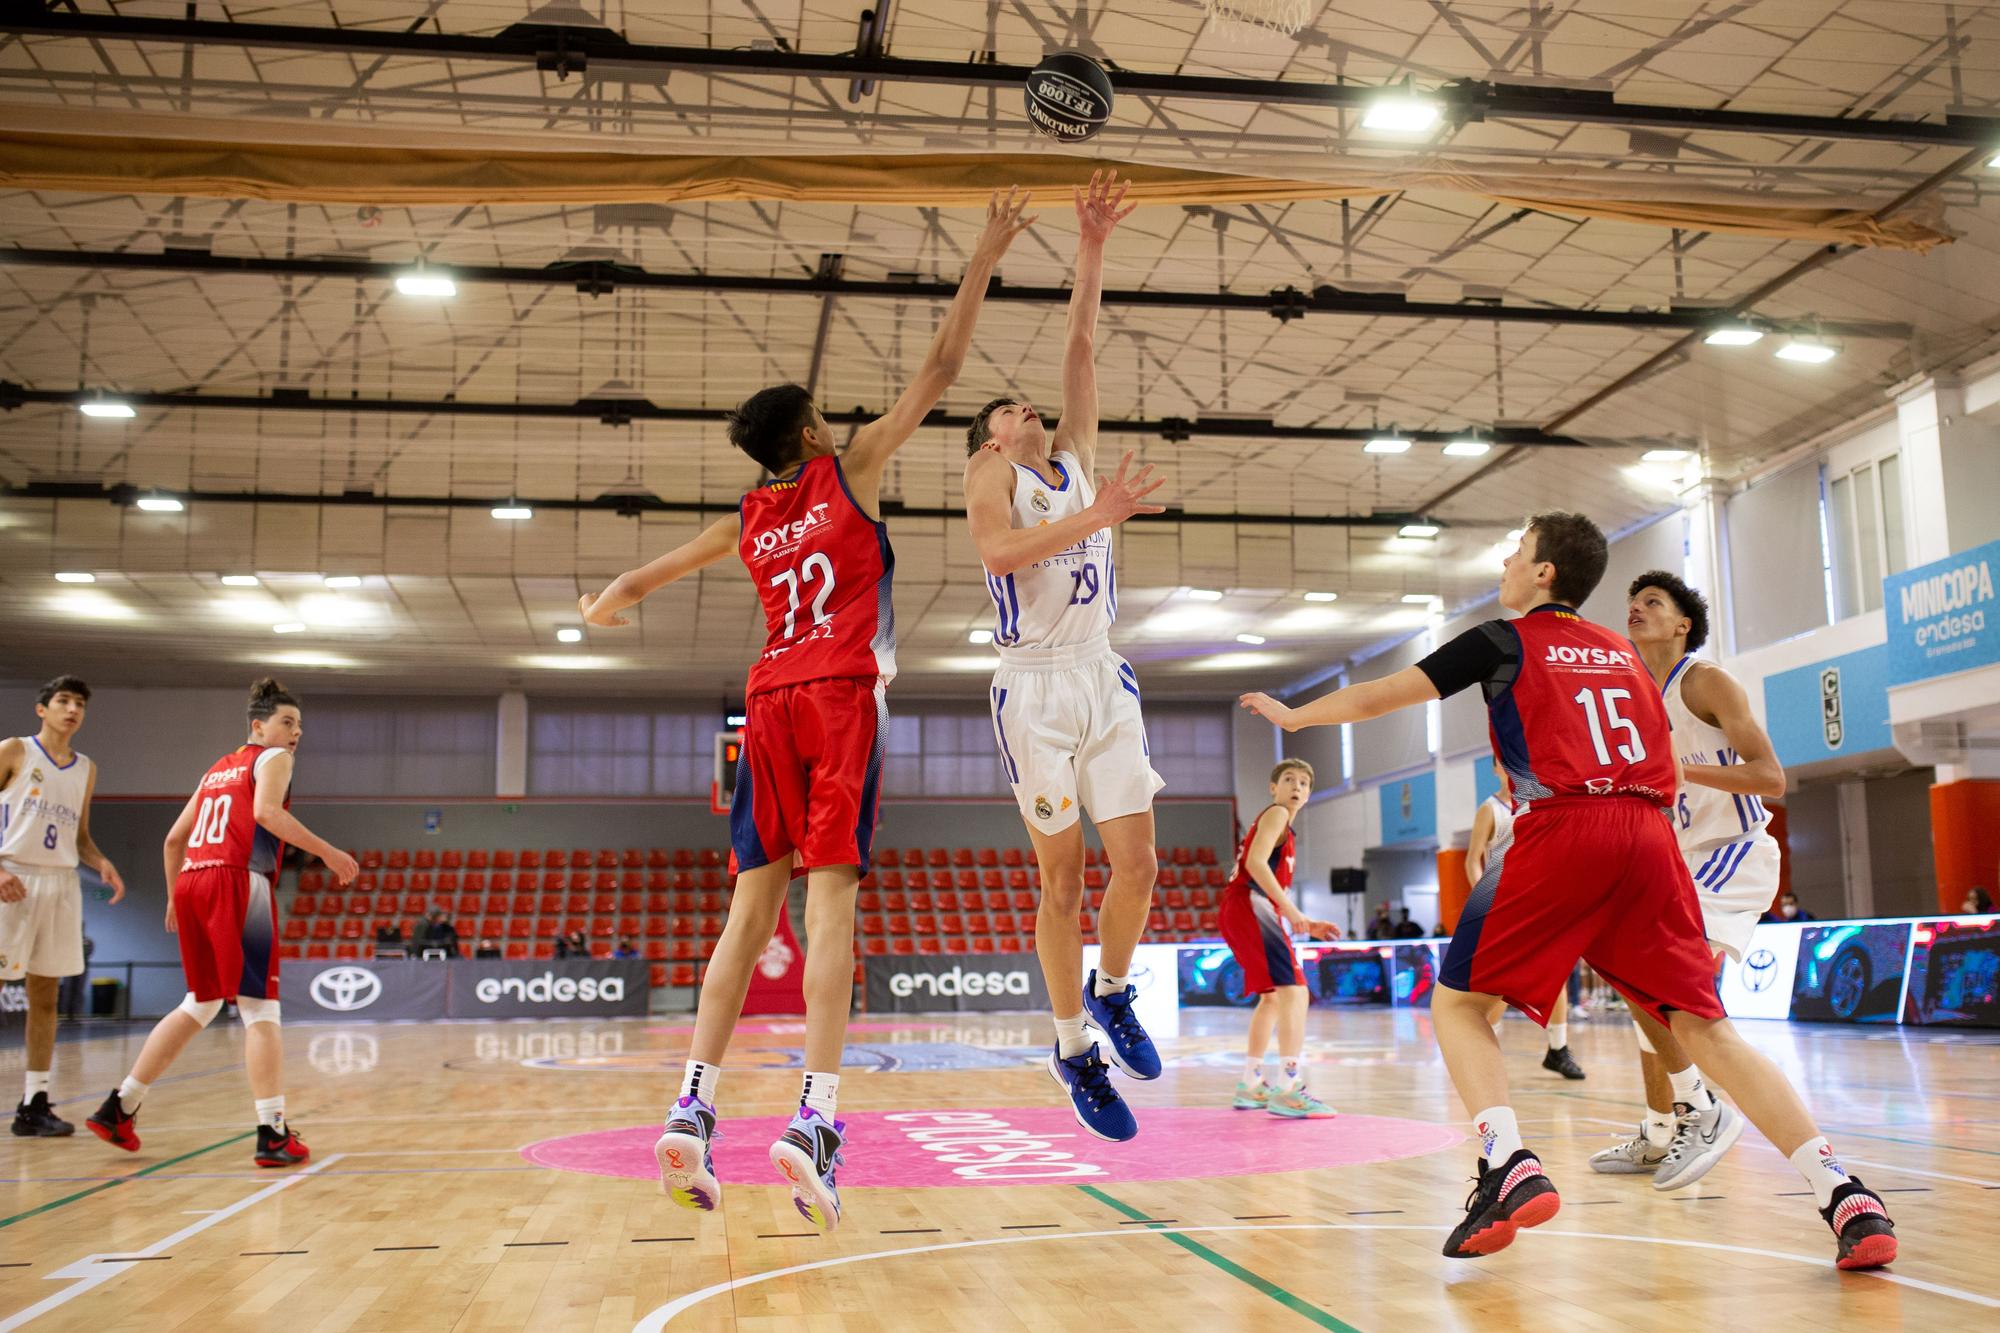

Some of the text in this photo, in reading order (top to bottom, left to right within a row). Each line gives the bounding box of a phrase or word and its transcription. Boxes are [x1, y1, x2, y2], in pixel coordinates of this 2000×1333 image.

[1029, 99, 1089, 136] SPALDING
[1038, 83, 1093, 115] TF-1000
[754, 503, 829, 557] JOYSAT
[770, 551, 836, 639] 72
[1902, 561, 1994, 624] MINICOPA
[1915, 611, 1984, 646] endesa
[1544, 645, 1633, 668] JOYSAT
[1574, 687, 1647, 766] 15
[43, 824, 58, 850] 8
[188, 794, 232, 848] 00
[475, 970, 625, 1003] endesa
[889, 966, 1030, 997] endesa
[884, 1111, 1110, 1180] endesa
